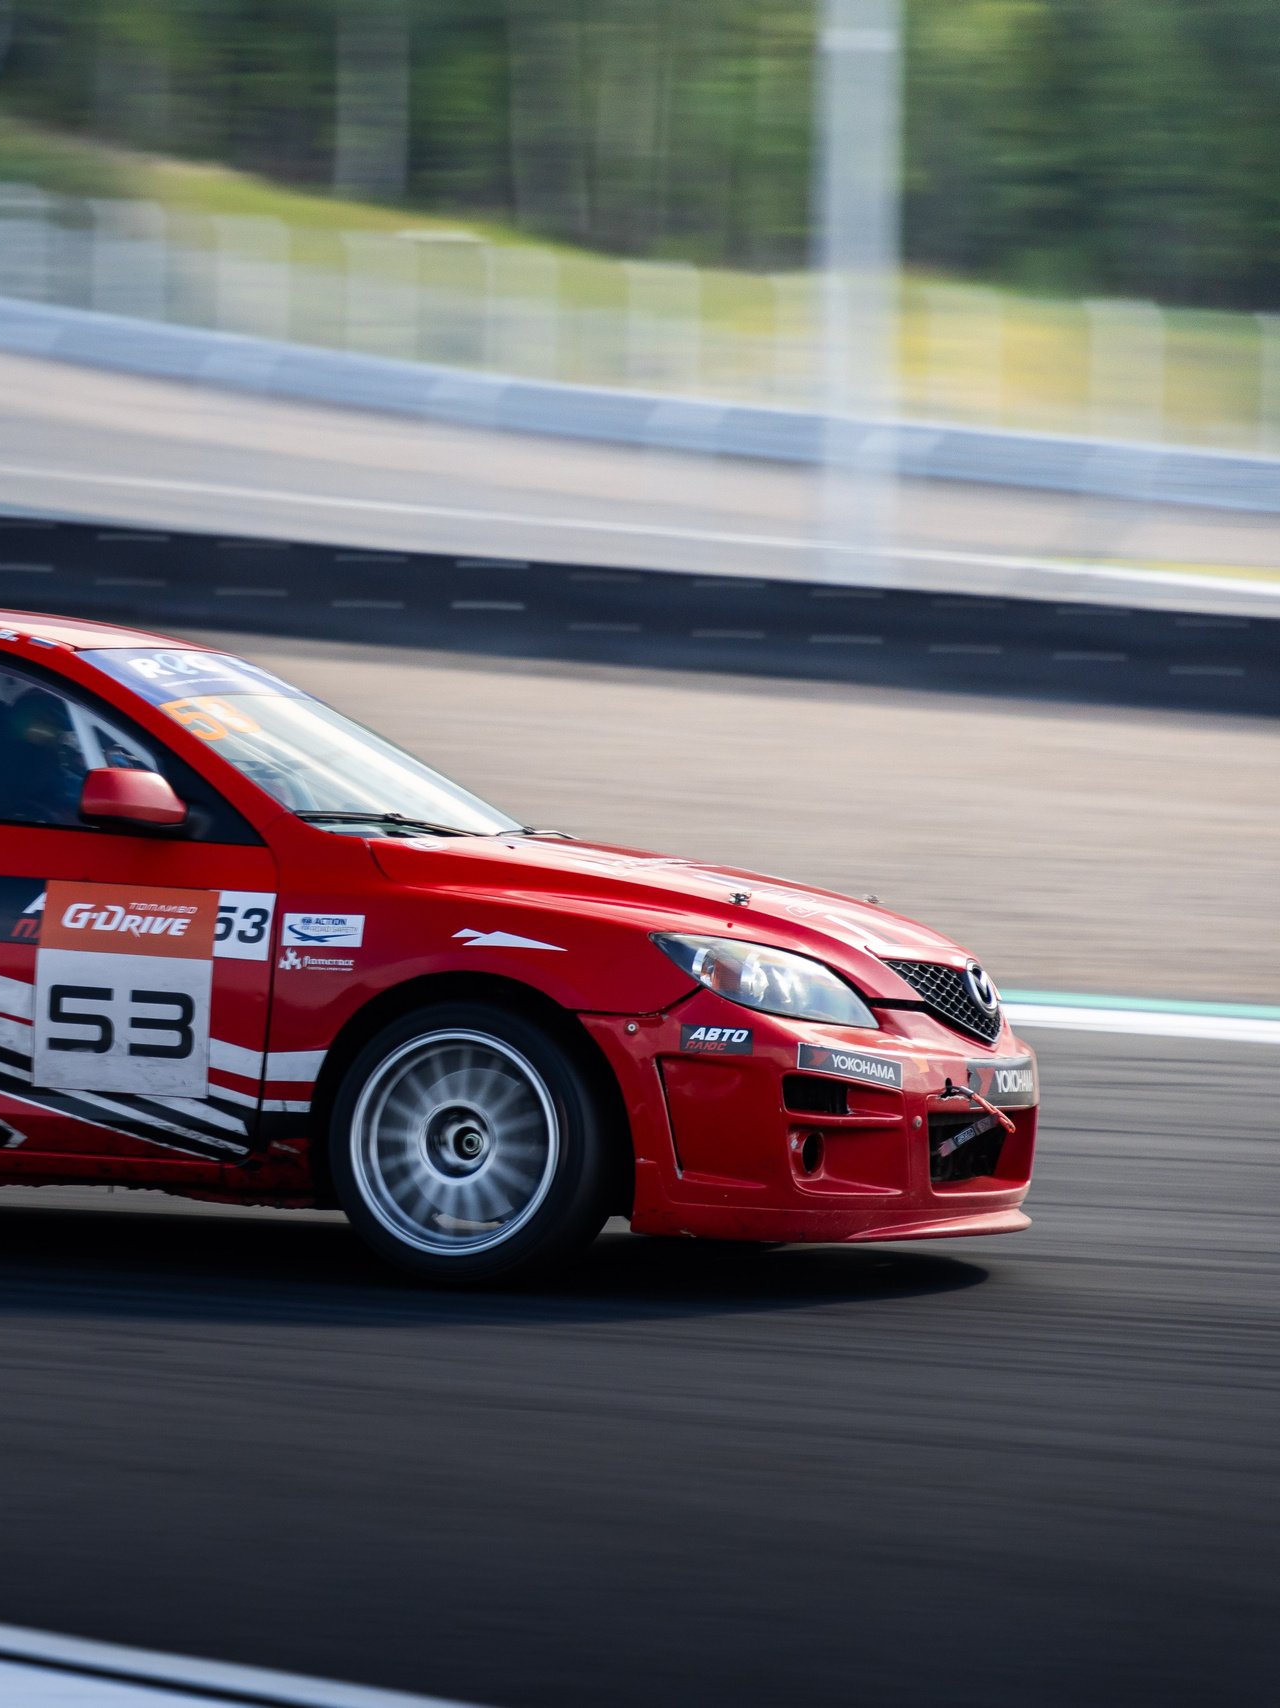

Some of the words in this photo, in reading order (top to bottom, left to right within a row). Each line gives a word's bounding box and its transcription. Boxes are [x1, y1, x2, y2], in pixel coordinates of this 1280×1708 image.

[159, 696, 261, 741] 53
[128, 902, 198, 915] ТОПЛИВО
[213, 906, 270, 944] 53
[47, 984, 196, 1060] 53
[690, 1027, 749, 1043] АВТО
[684, 1040, 728, 1051] ПЛЮС
[831, 1053, 896, 1081] YOKOHAMA
